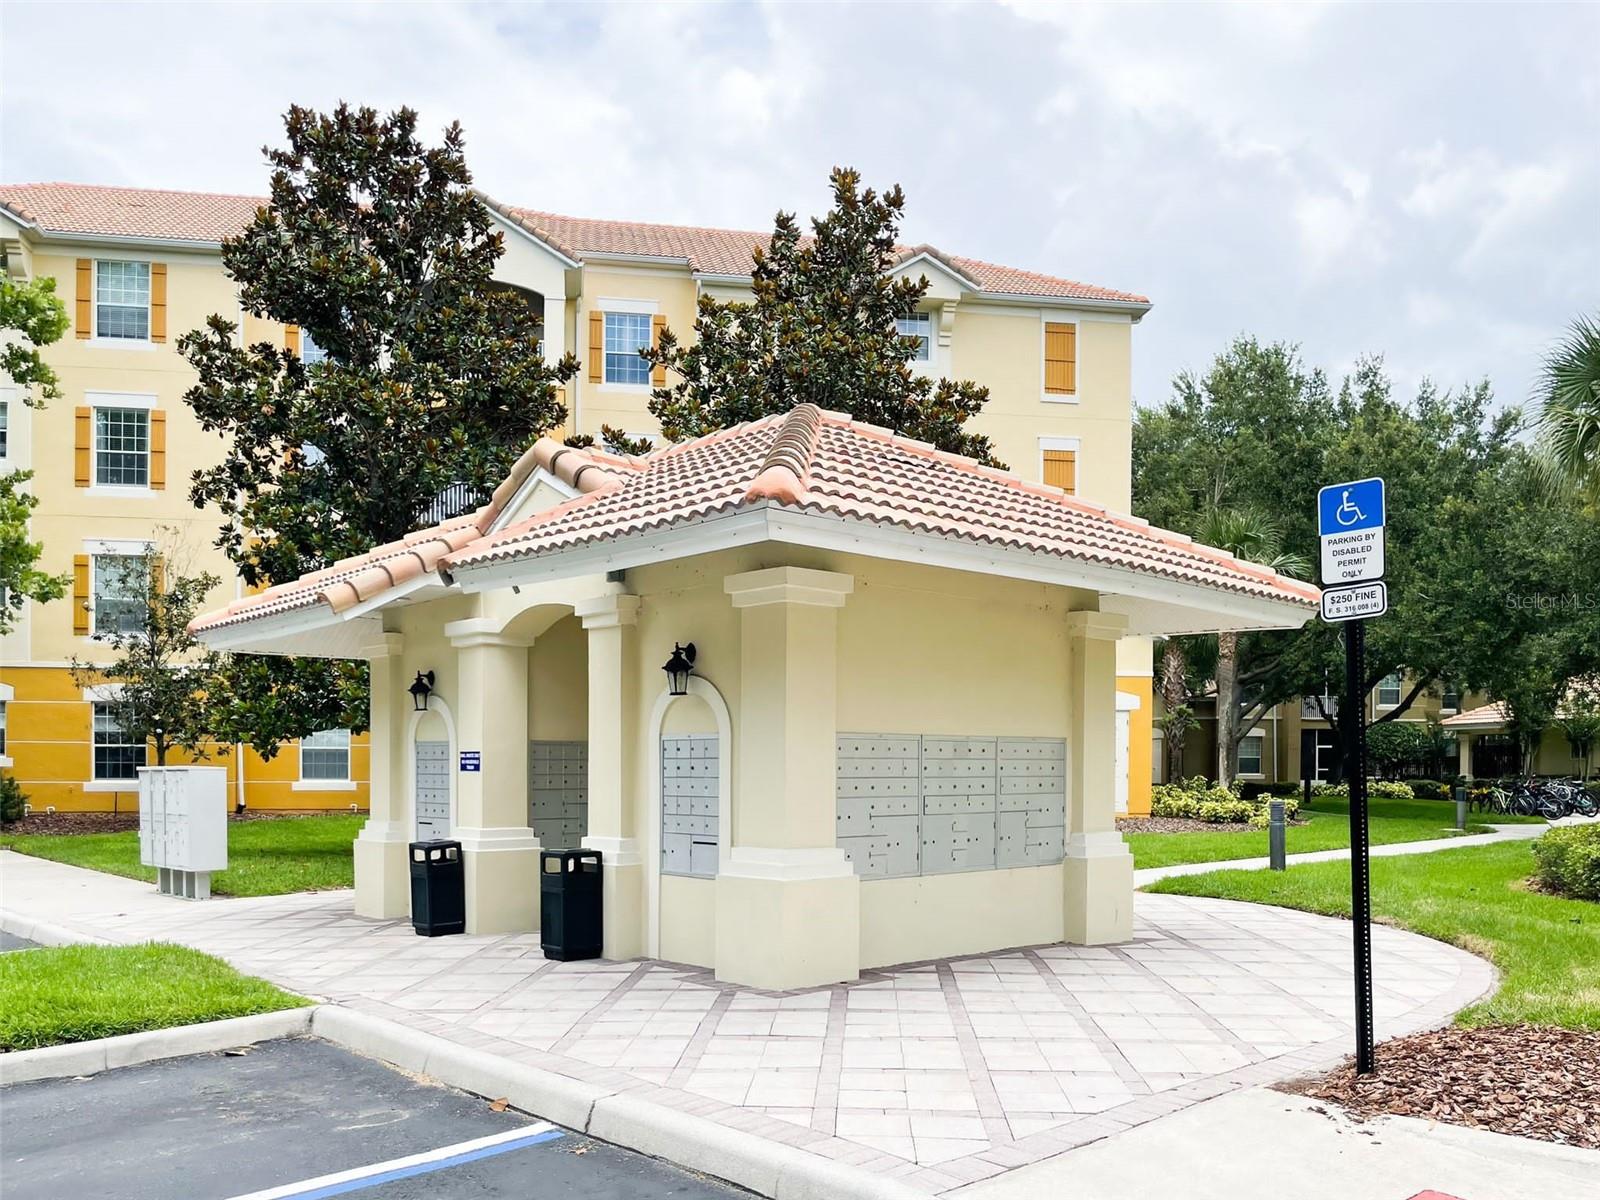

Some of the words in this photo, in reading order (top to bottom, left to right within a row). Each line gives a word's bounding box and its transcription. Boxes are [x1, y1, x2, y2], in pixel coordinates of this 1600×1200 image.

[1327, 535, 1363, 546] PARKING
[1364, 533, 1376, 541] BY
[1332, 545, 1372, 556] DISABLED
[1337, 557, 1367, 567] PERMIT
[1342, 569, 1363, 578] ONLY
[1330, 594, 1352, 604] $250
[1355, 591, 1377, 601] FINE
